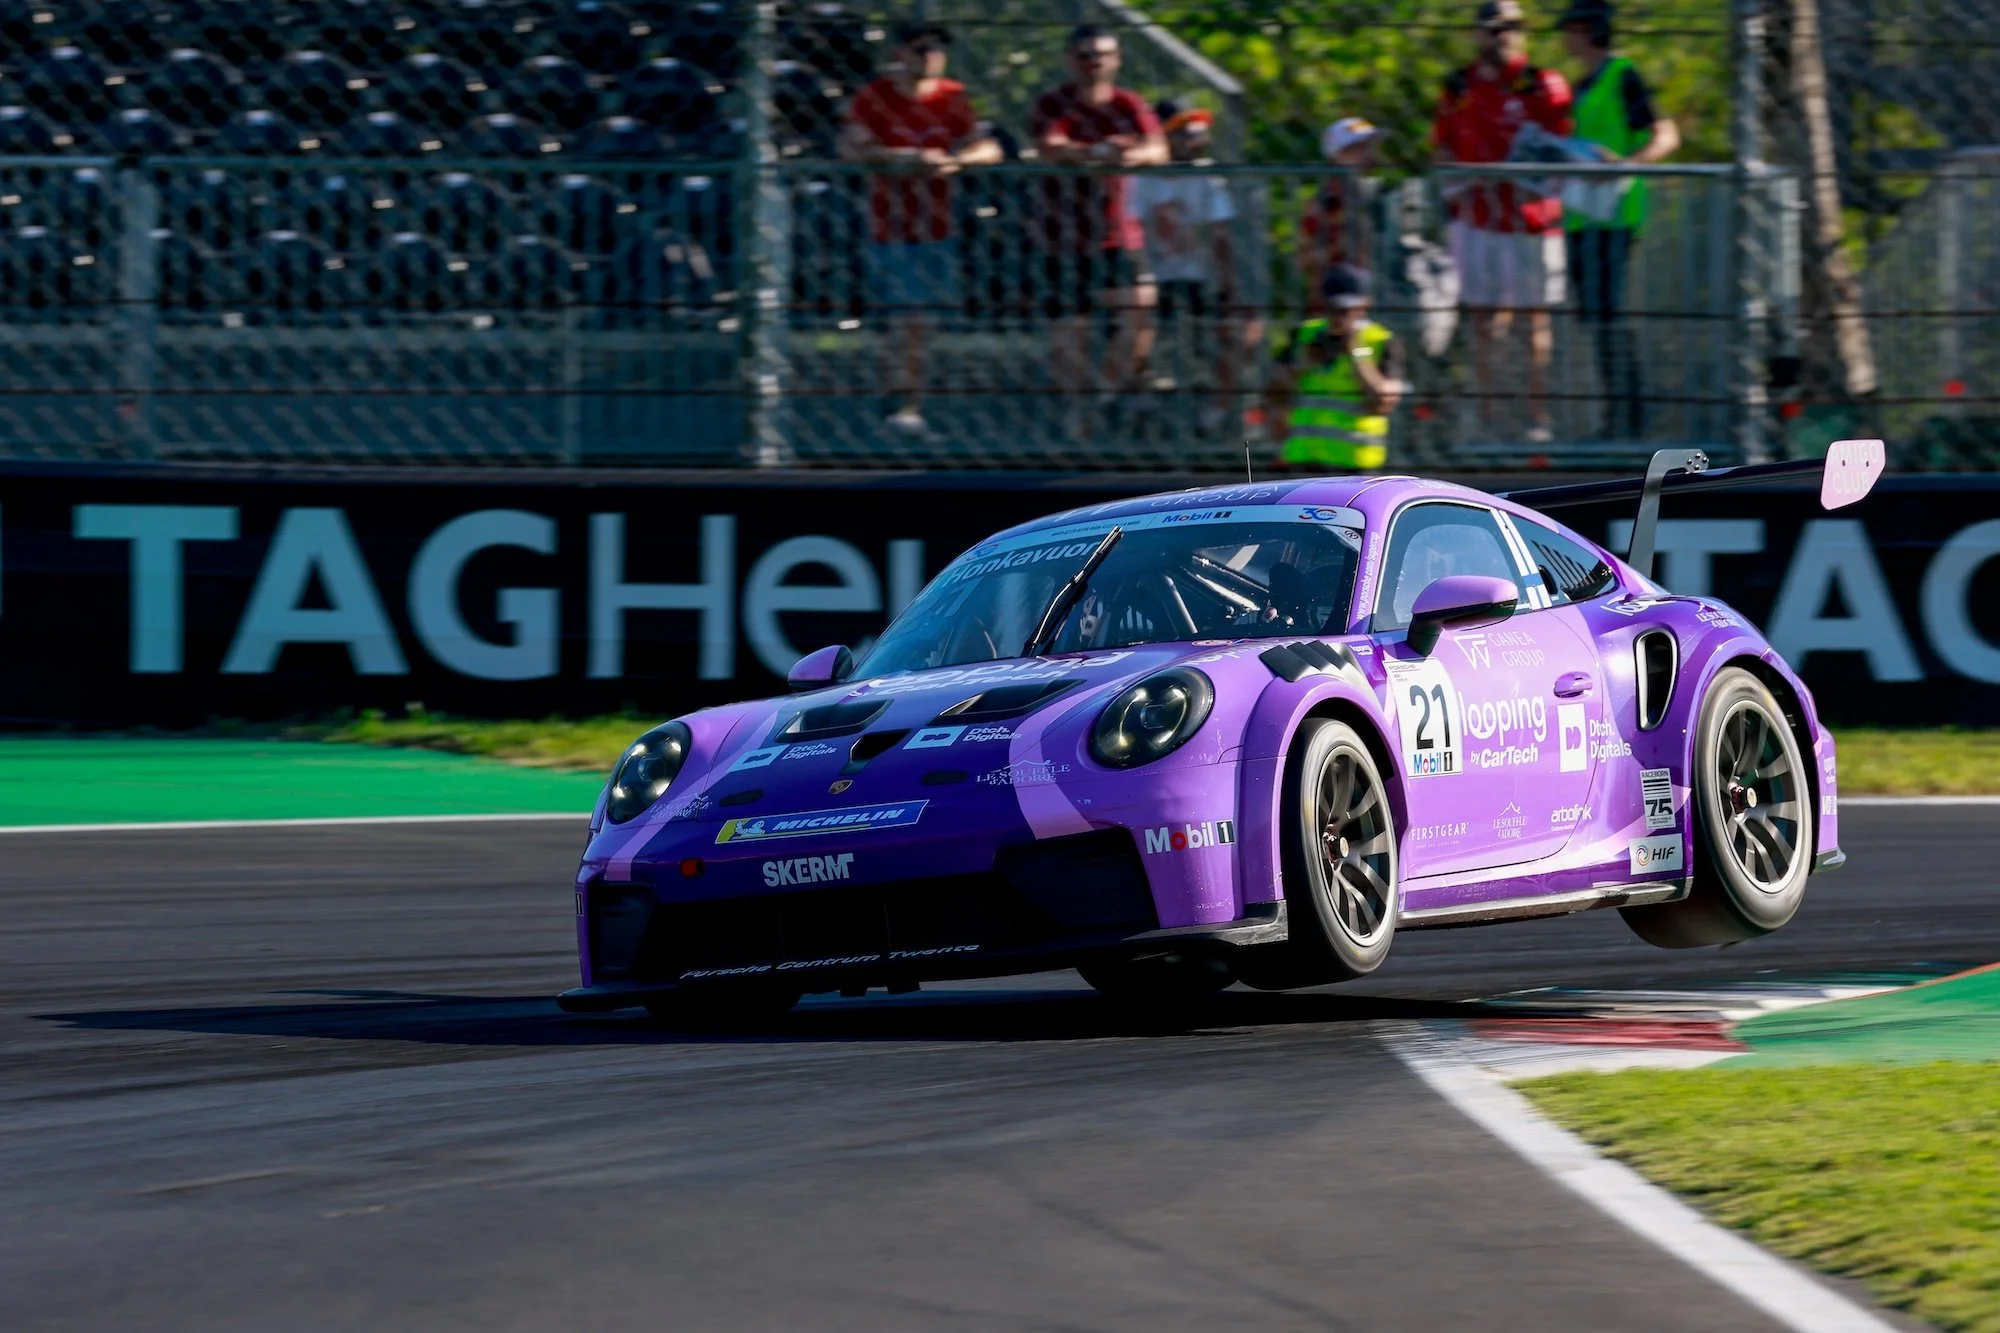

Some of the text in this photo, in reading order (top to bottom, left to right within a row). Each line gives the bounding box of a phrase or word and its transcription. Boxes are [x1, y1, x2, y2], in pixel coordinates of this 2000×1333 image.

[1162, 511, 1213, 524] Mobil
[941, 541, 1101, 588] Honkavuor
[1409, 684, 1451, 750] 21
[1458, 690, 1548, 747] looping
[962, 731, 1022, 743] Digitals
[1413, 751, 1453, 774] Mobil 1
[1470, 743, 1539, 769] by CarTech
[1590, 738, 1633, 764] Digitals
[772, 808, 906, 831] MICHELIN
[1645, 798, 1673, 816] 75
[1144, 821, 1232, 855] Mobil 1
[1652, 846, 1675, 861] HIF
[776, 954, 881, 970] Centrum
[889, 944, 979, 959] Twente
